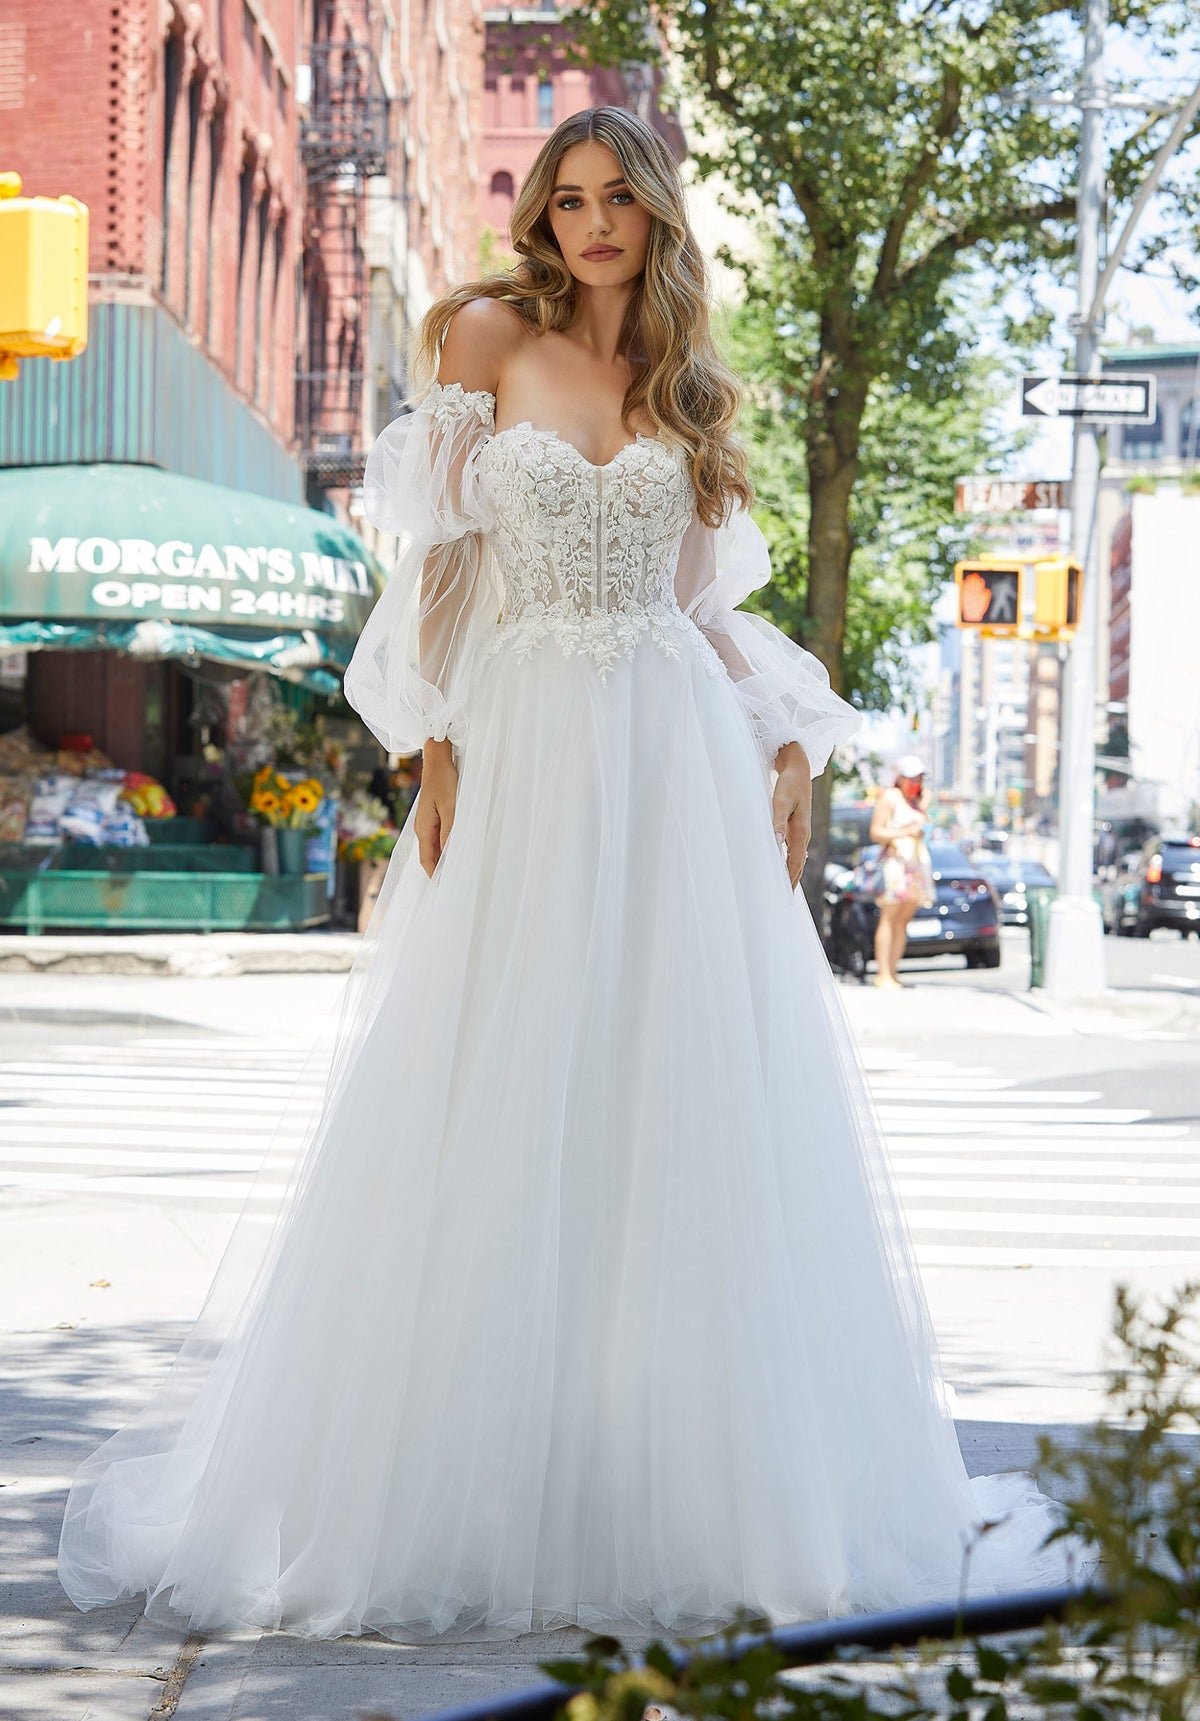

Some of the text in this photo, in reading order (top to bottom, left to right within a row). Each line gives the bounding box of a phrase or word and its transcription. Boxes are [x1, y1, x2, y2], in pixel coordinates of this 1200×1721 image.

[27, 537, 295, 585] MORGAN'S
[91, 581, 344, 623] OPEN 24HRS
